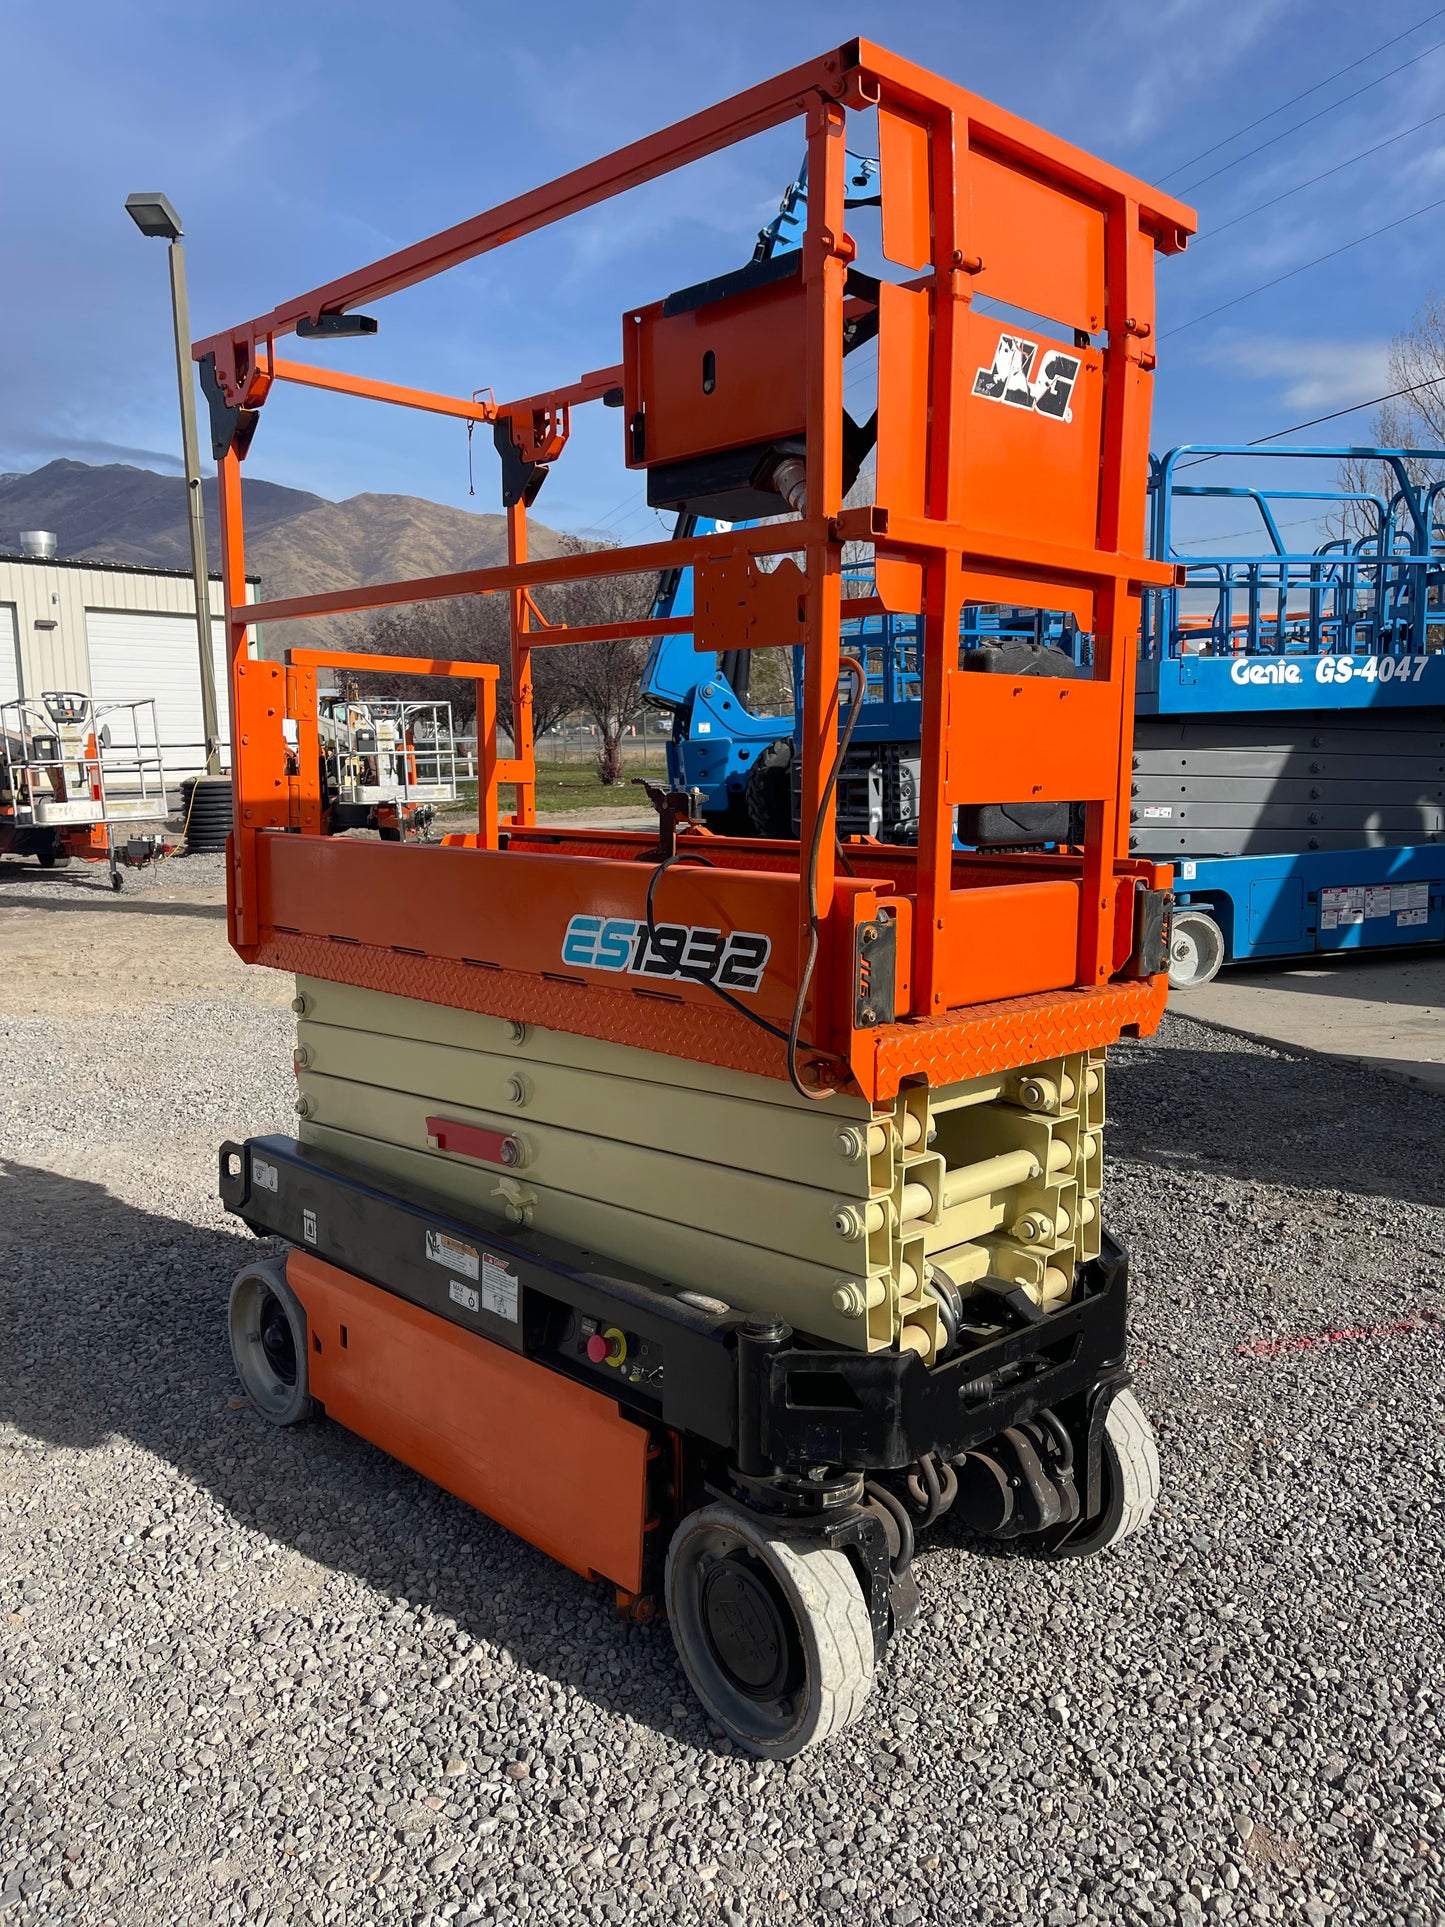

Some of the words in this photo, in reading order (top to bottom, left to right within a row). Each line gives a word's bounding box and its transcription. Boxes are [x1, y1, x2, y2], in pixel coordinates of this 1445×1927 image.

[971, 333, 1081, 421] JLG
[1230, 658, 1301, 685] Genie
[1315, 655, 1429, 684] GS-4047
[563, 916, 770, 990] ES1932
[859, 952, 871, 999] JLG
